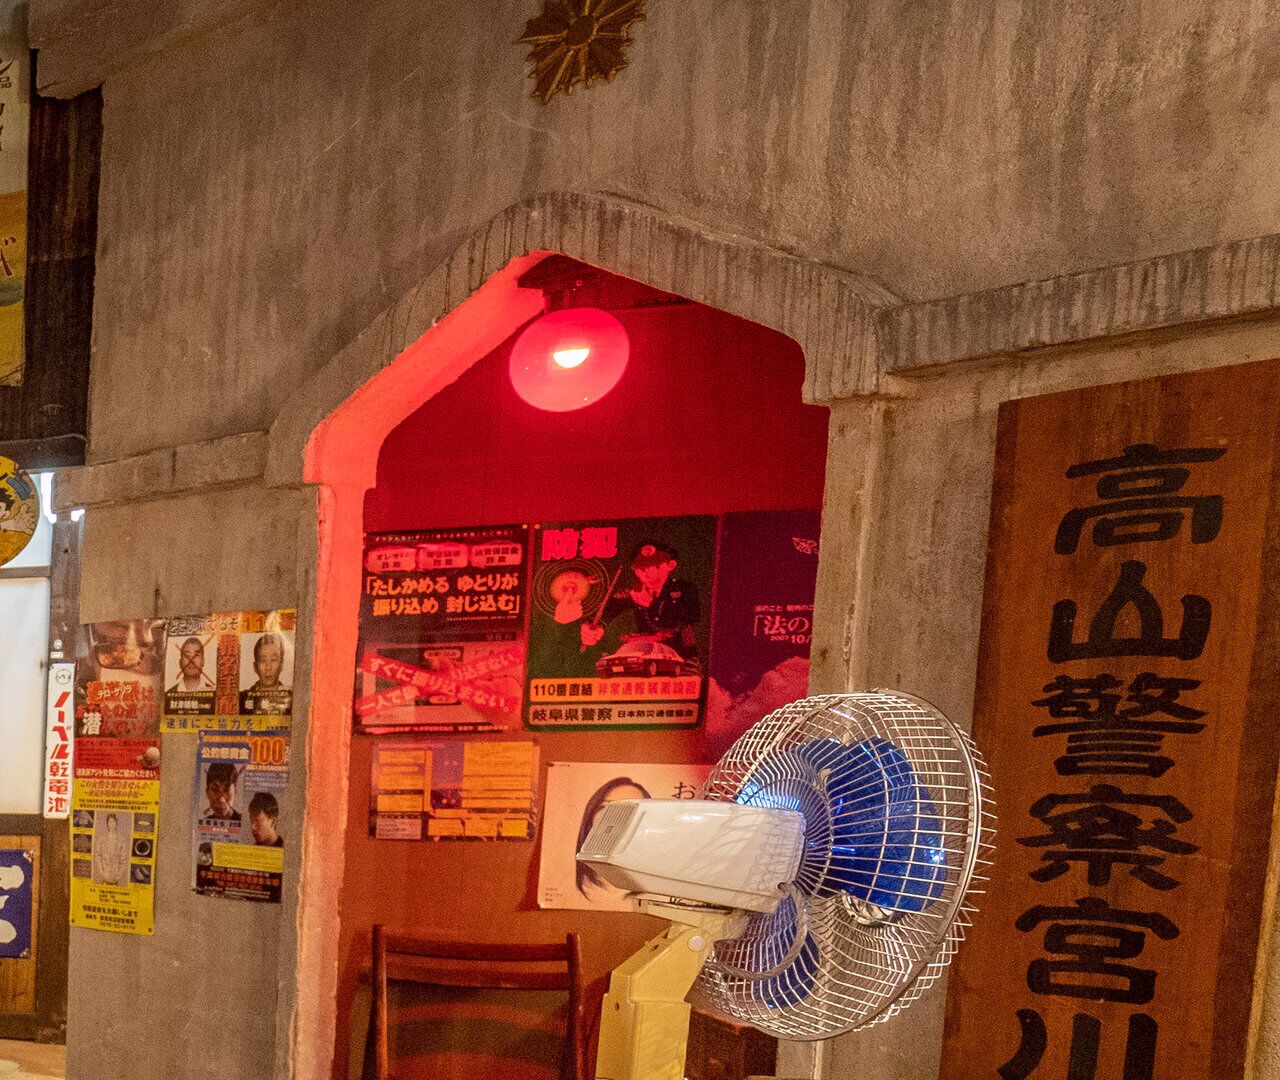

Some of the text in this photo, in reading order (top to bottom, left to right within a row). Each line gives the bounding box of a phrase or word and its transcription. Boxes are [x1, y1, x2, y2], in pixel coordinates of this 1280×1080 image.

[542, 527, 618, 561] 防犯
[367, 573, 518, 596] 「たしかめる ゆとりが
[373, 594, 519, 616] 振り込め 封じ込む」
[754, 615, 809, 637] 「法の
[533, 683, 593, 696] 110番直結
[532, 707, 613, 722] 岐阜県警察
[48, 691, 71, 814] ノーベル乾電池
[250, 736, 285, 764] 100
